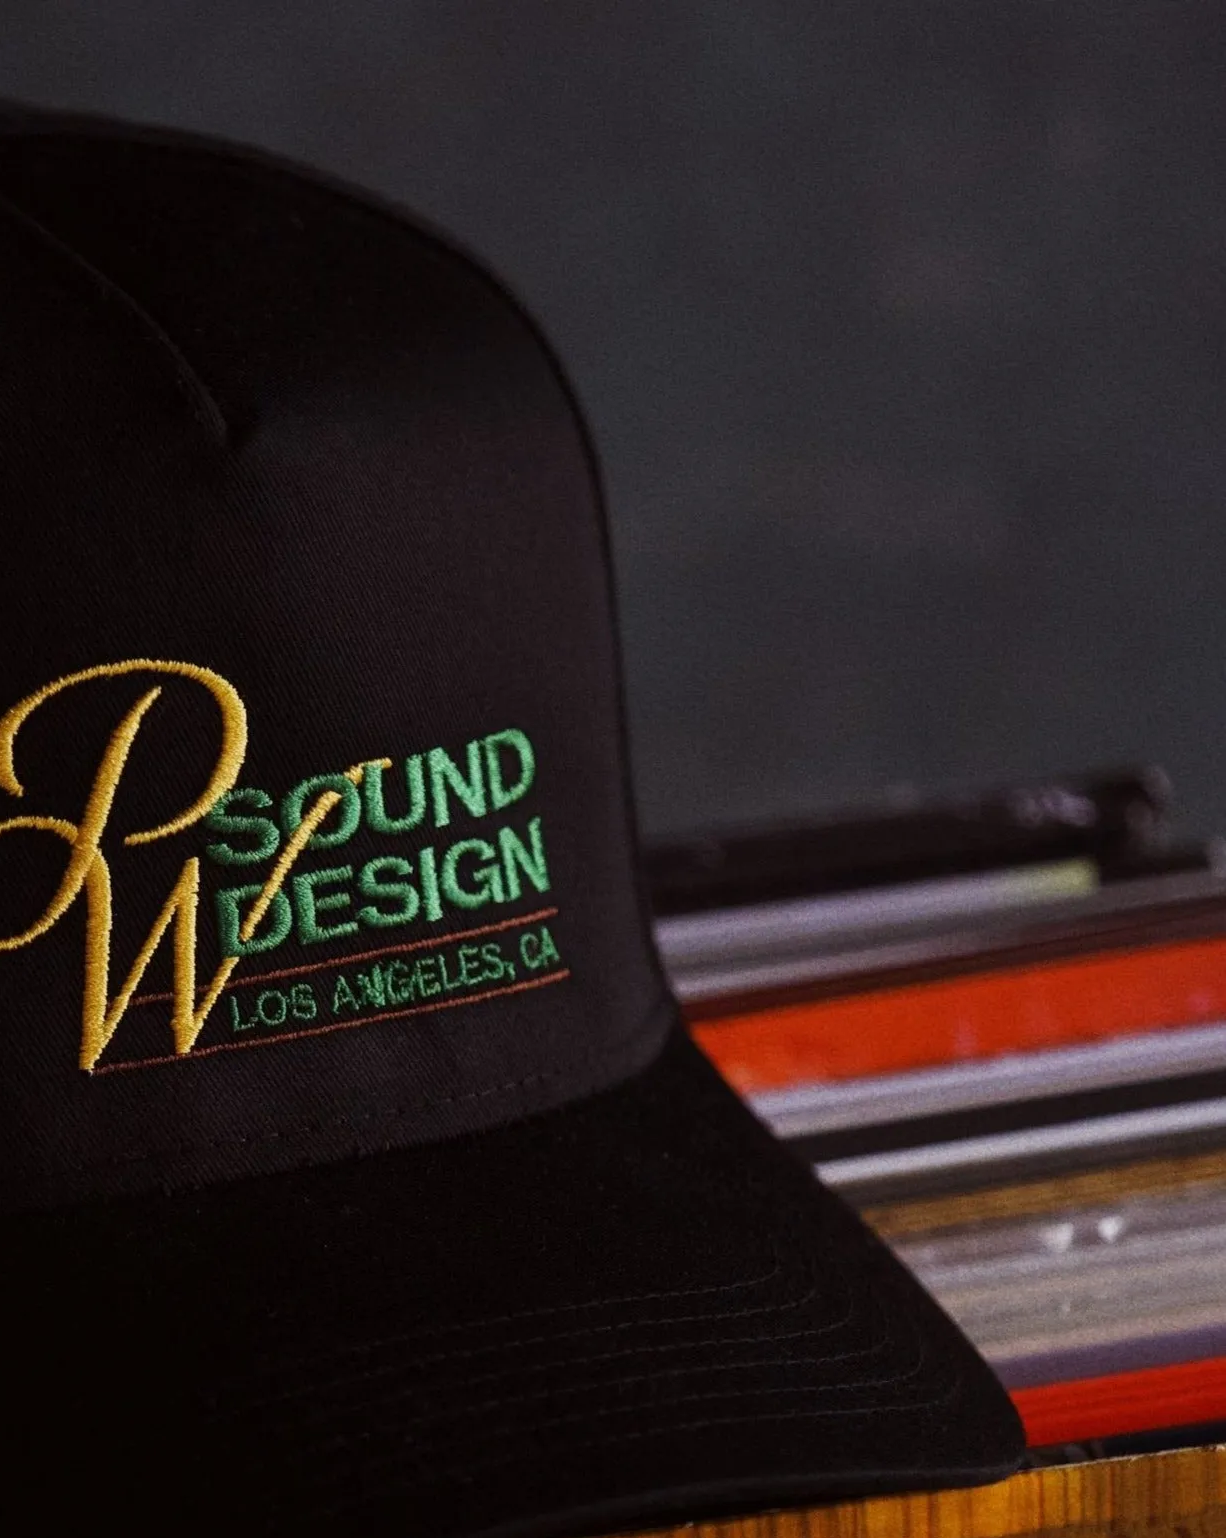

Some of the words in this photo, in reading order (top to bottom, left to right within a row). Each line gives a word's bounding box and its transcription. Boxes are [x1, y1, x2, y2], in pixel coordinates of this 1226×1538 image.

[206, 728, 536, 866] SOUND
[217, 815, 552, 958] DESIGN
[230, 982, 317, 1033] LOS
[332, 942, 516, 1015] ANGELES,
[519, 925, 560, 970] CA
